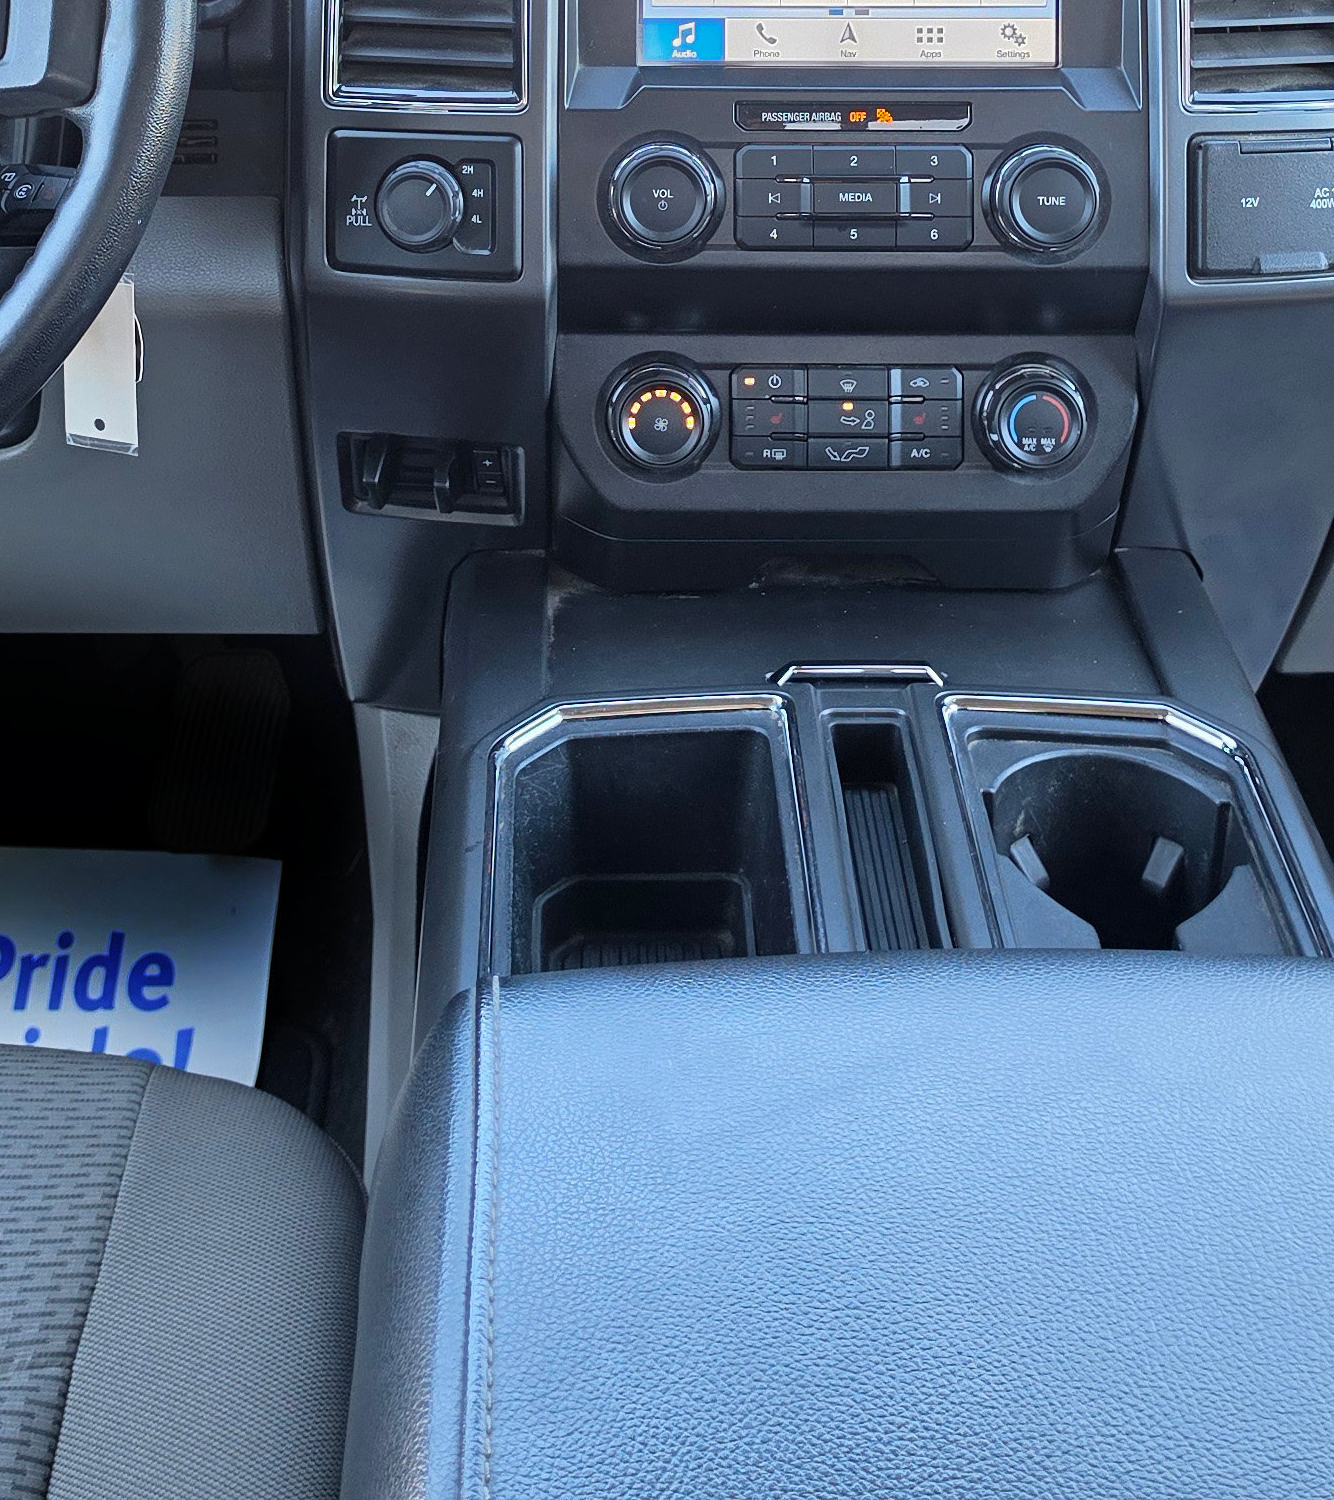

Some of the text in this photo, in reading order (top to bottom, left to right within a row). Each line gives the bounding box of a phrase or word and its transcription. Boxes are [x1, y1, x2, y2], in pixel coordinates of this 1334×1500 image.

[671, 49, 697, 59] Audio
[753, 49, 780, 58] Phone
[840, 50, 857, 58] Nav
[920, 50, 942, 60] Apps
[996, 49, 1031, 60] Settings
[762, 111, 867, 122] PASSENGER AIRBAG OFF
[770, 156, 777, 166] 1
[850, 156, 858, 167] 2
[930, 156, 938, 166] 3
[461, 165, 474, 174] 2H
[472, 188, 484, 198] 4H
[652, 189, 674, 198] VOL
[839, 192, 873, 202] MEDIA
[1314, 187, 1330, 198] AC
[1037, 196, 1066, 206] TUNE
[1240, 196, 1260, 208] 12V
[346, 215, 373, 227] PULL
[471, 214, 482, 224] 4L
[769, 229, 778, 240] 4
[850, 229, 857, 239] 5
[930, 229, 939, 239] 6
[1022, 437, 1037, 445] MAX
[1040, 437, 1056, 445] MAX
[1023, 444, 1036, 452] A/C
[910, 448, 931, 459] A/C
